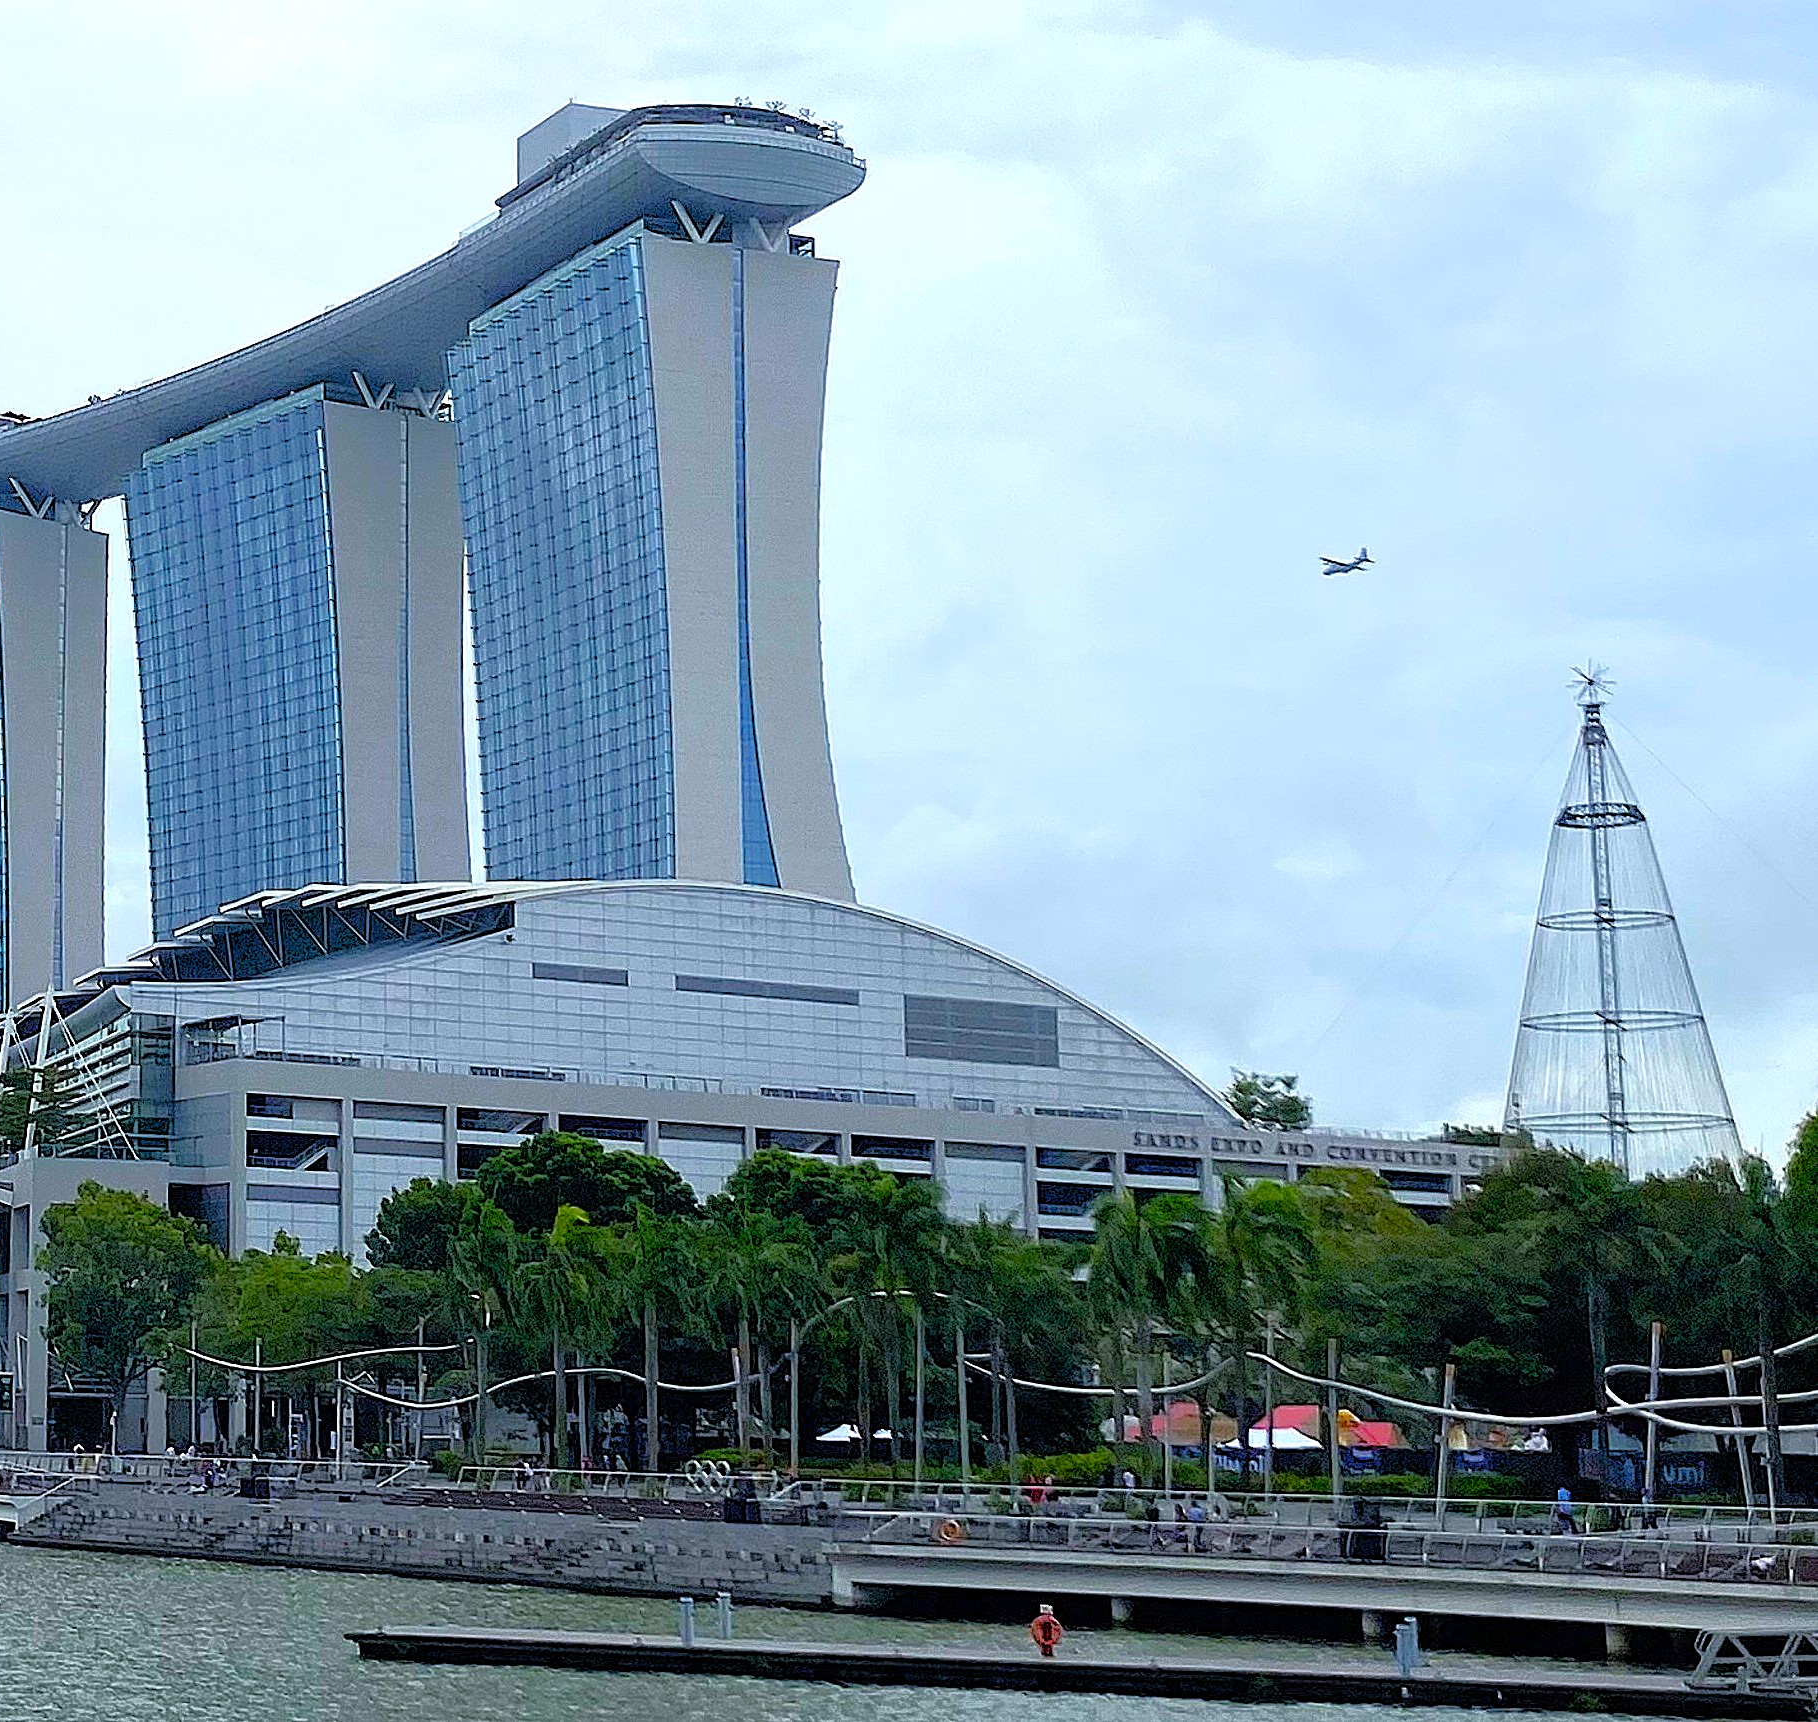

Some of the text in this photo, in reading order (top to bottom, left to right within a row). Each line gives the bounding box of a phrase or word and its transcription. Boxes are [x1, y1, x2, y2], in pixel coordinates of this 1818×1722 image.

[1134, 1131, 1199, 1149] SANDS
[1211, 1136, 1262, 1154] EXPO
[1278, 1141, 1314, 1157] AND
[1327, 1145, 1457, 1166] CONVENTION
